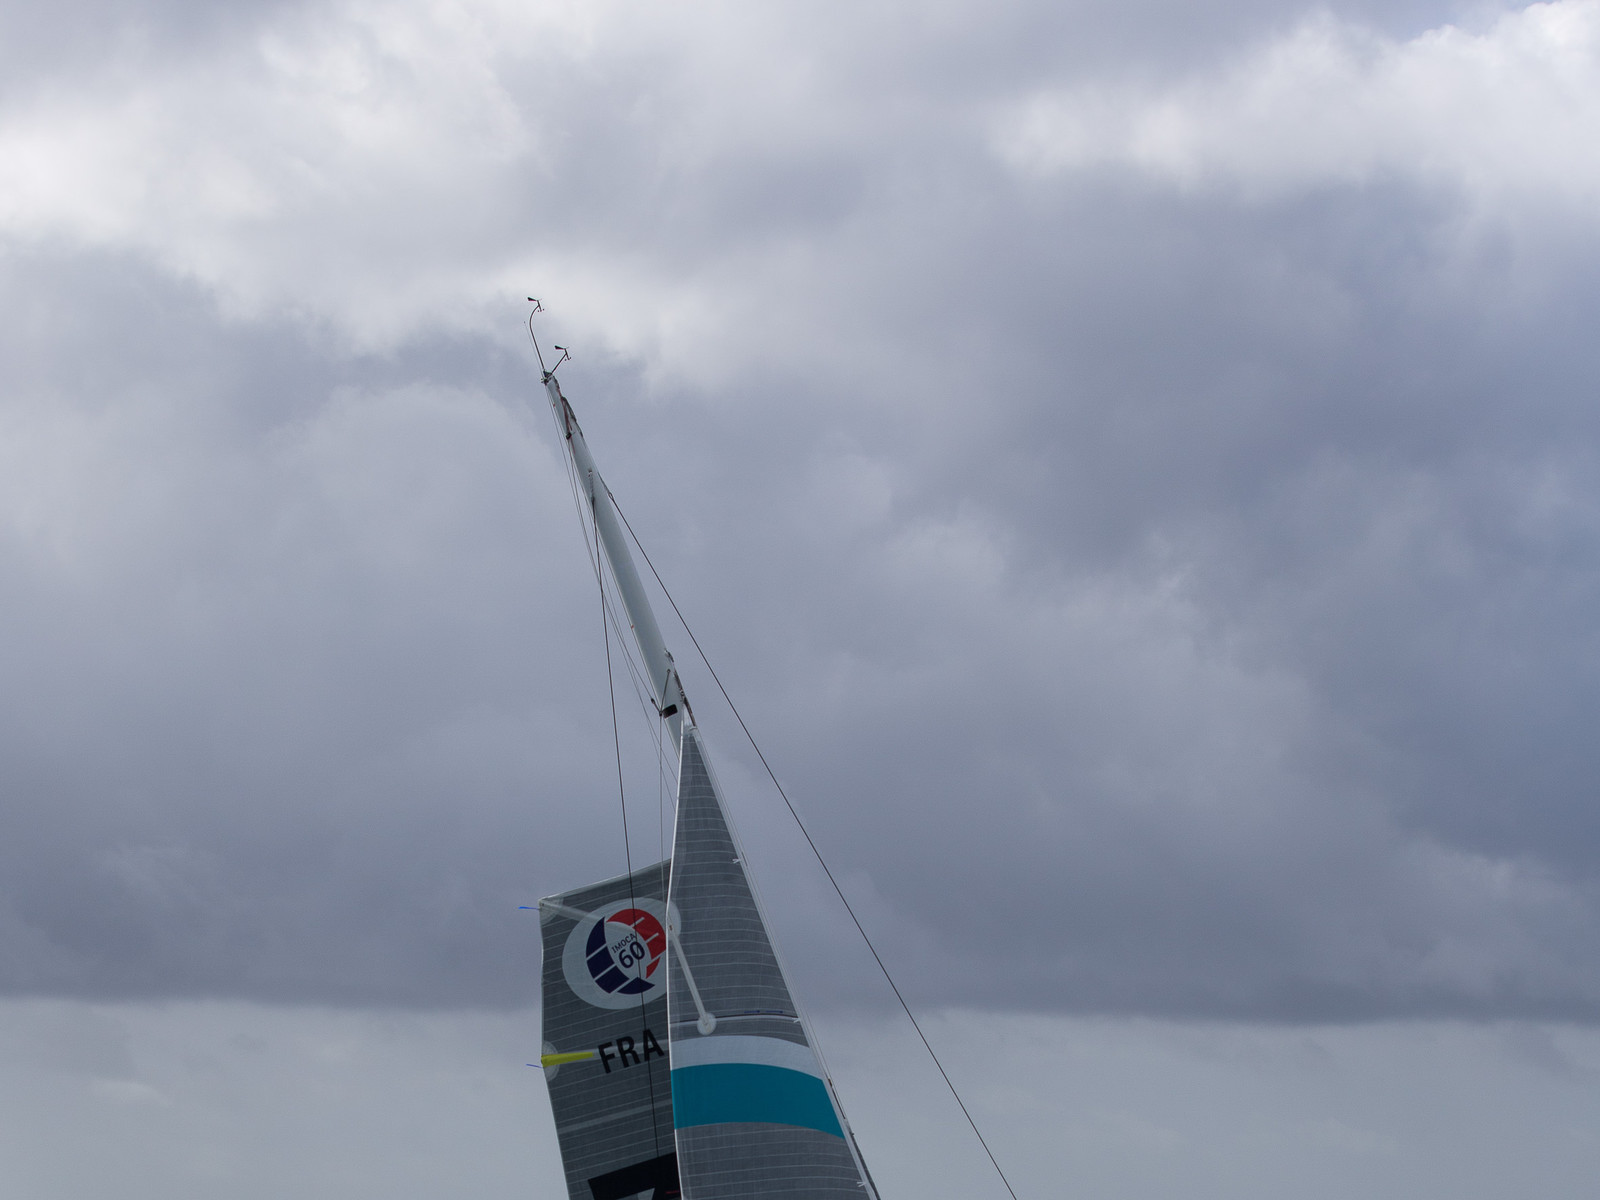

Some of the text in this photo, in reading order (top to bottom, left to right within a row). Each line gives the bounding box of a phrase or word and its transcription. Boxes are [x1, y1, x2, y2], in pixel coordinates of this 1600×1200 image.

[611, 932, 637, 954] IMOCA
[618, 941, 645, 969] 60
[598, 1028, 665, 1074] FRA
